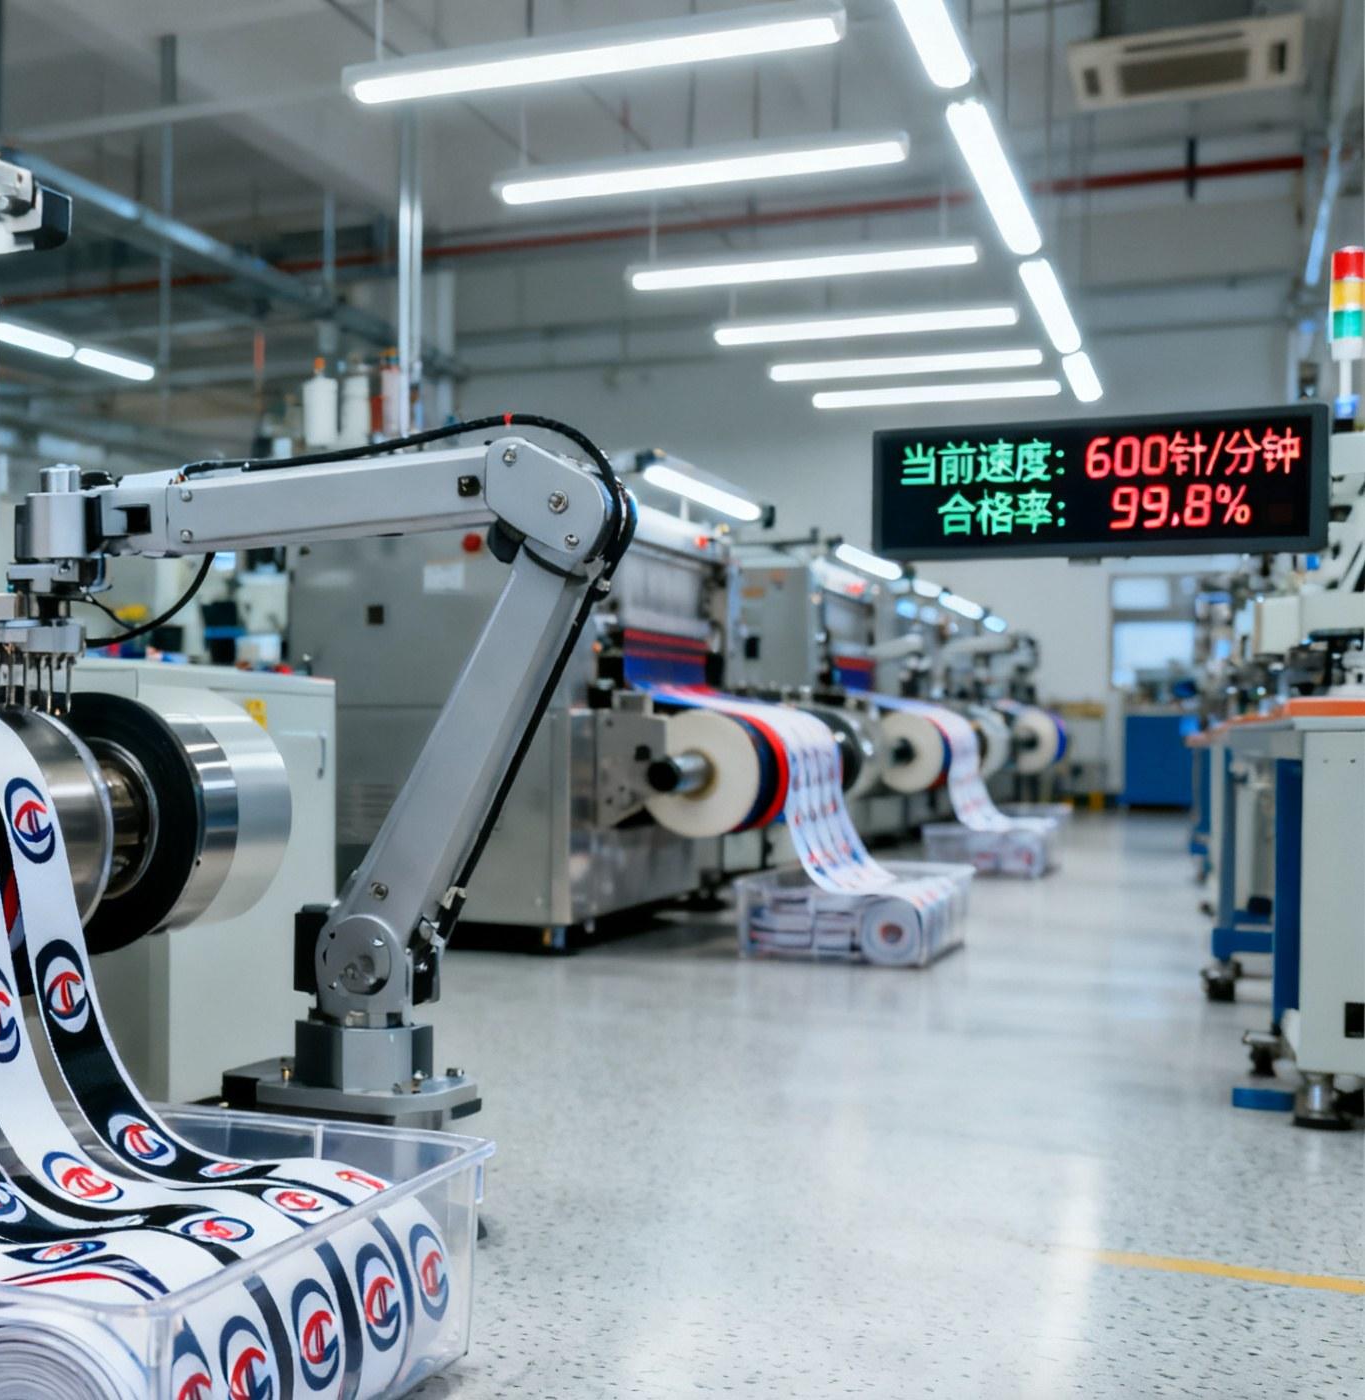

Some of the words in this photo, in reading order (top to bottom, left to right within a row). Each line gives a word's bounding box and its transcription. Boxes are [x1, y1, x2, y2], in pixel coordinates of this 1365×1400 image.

[900, 437, 1066, 486] 当前速度：
[1085, 426, 1301, 479] 600针/分钟
[937, 488, 1067, 536] 合格率：
[1109, 483, 1251, 530] 99.8%
